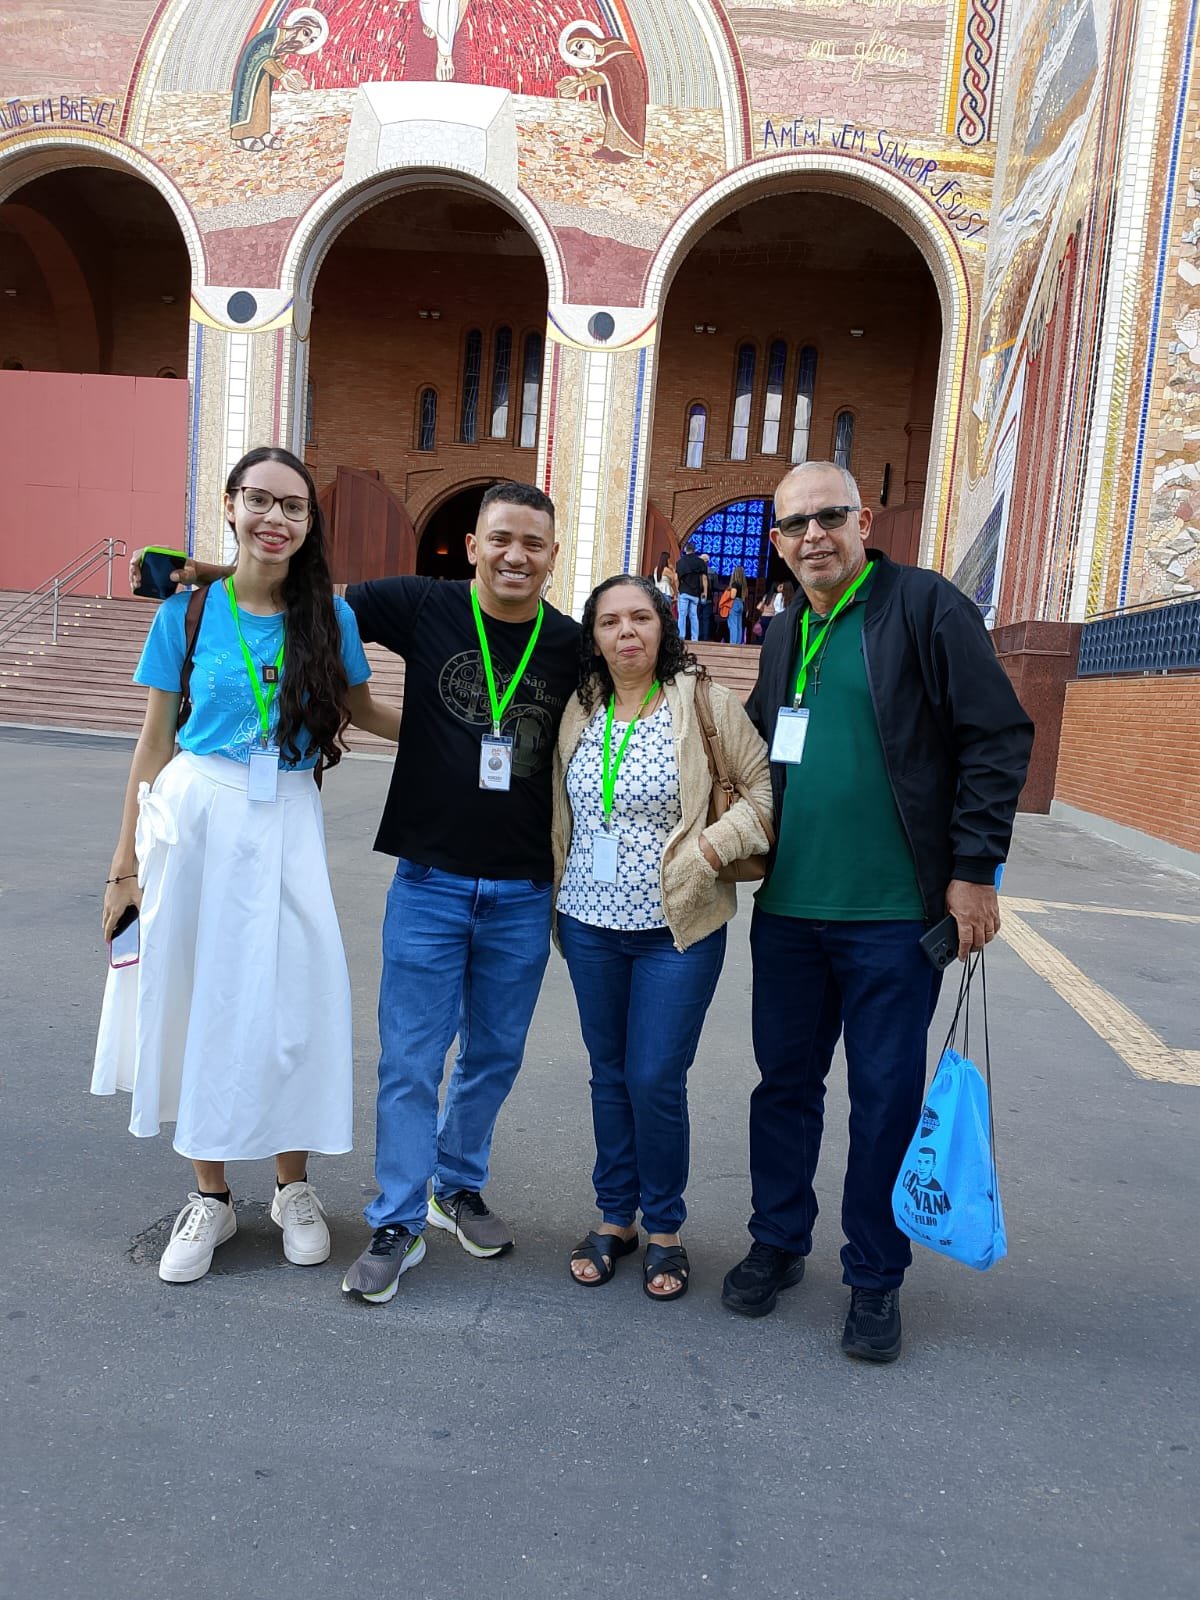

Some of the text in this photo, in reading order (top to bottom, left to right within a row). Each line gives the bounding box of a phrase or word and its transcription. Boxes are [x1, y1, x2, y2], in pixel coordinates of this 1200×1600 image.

[32, 98, 55, 124] EM
[763, 116, 822, 149] AMÉM!
[871, 129, 938, 186] SENHOR
[930, 179, 985, 241] JESUS!
